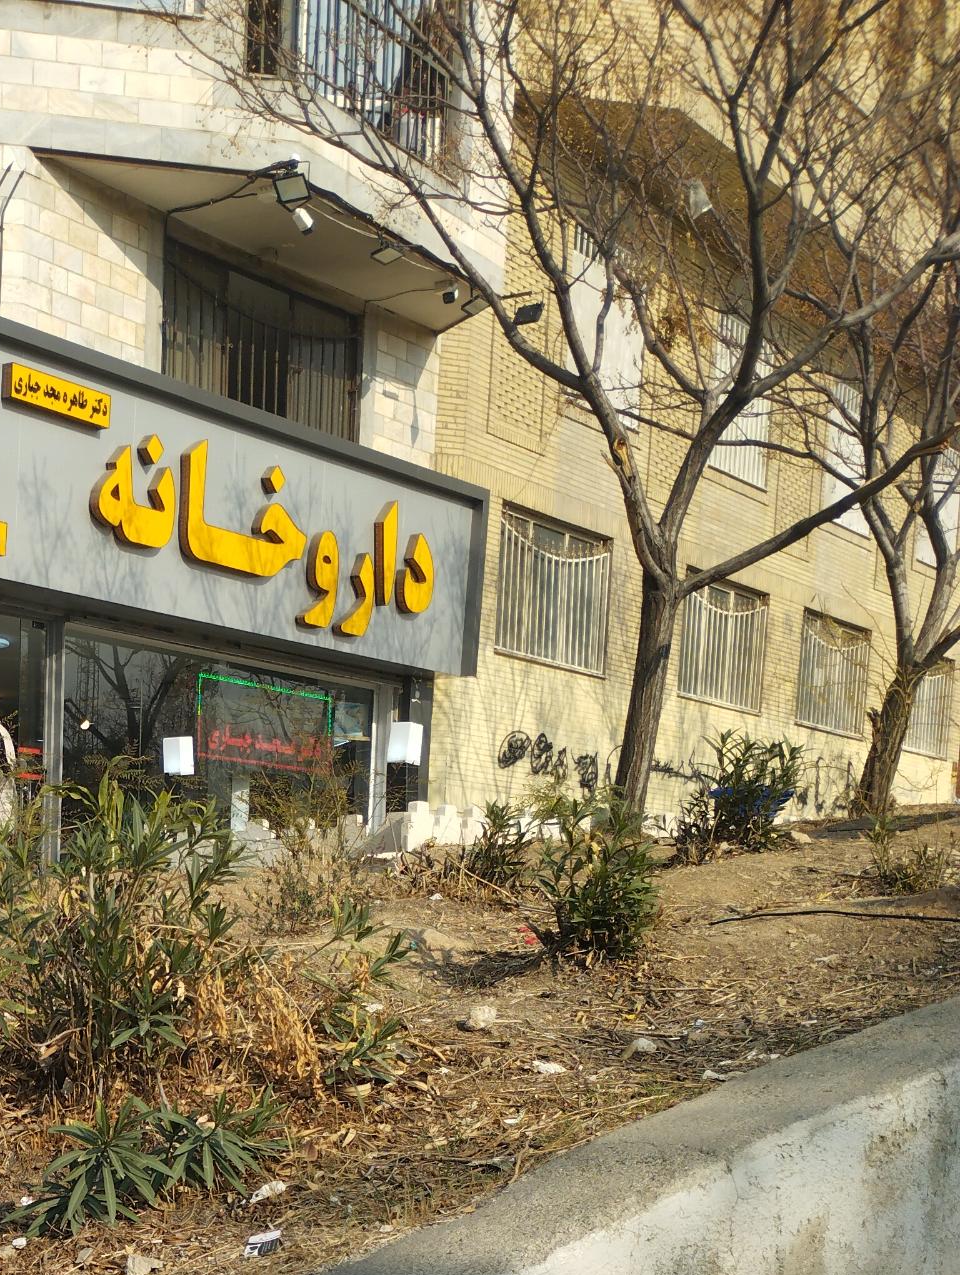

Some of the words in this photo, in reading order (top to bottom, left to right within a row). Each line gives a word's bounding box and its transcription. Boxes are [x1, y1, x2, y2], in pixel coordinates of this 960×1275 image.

[13, 373, 42, 400] جباری
[43, 383, 61, 405] مجد
[62, 389, 88, 412] طاهره
[89, 398, 108, 419] دکتر
[89, 433, 435, 637] داروخانه
